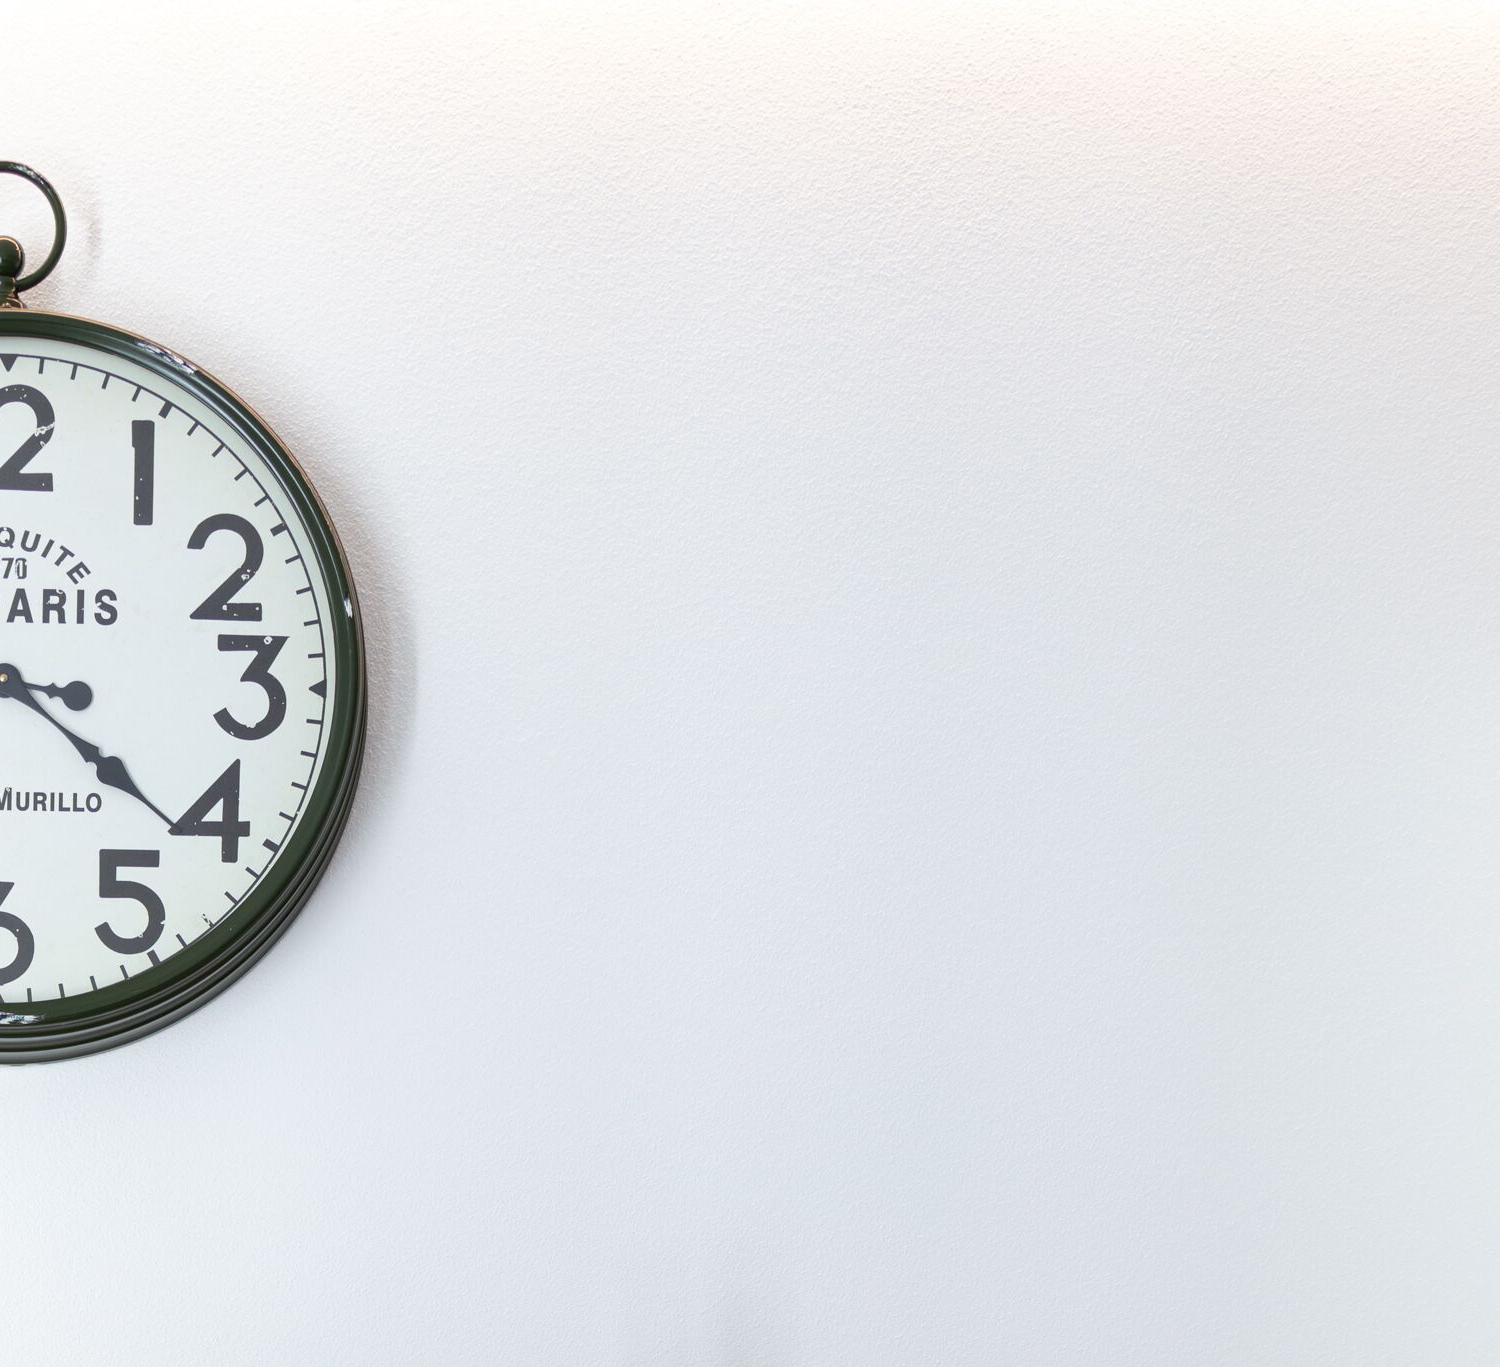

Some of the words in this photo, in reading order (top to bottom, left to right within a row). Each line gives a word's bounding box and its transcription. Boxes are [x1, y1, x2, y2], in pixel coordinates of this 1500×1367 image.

[131, 420, 155, 525] 1
[187, 514, 264, 621] 2
[213, 634, 289, 741] 3
[167, 759, 250, 864] 4
[95, 849, 165, 954] 5
